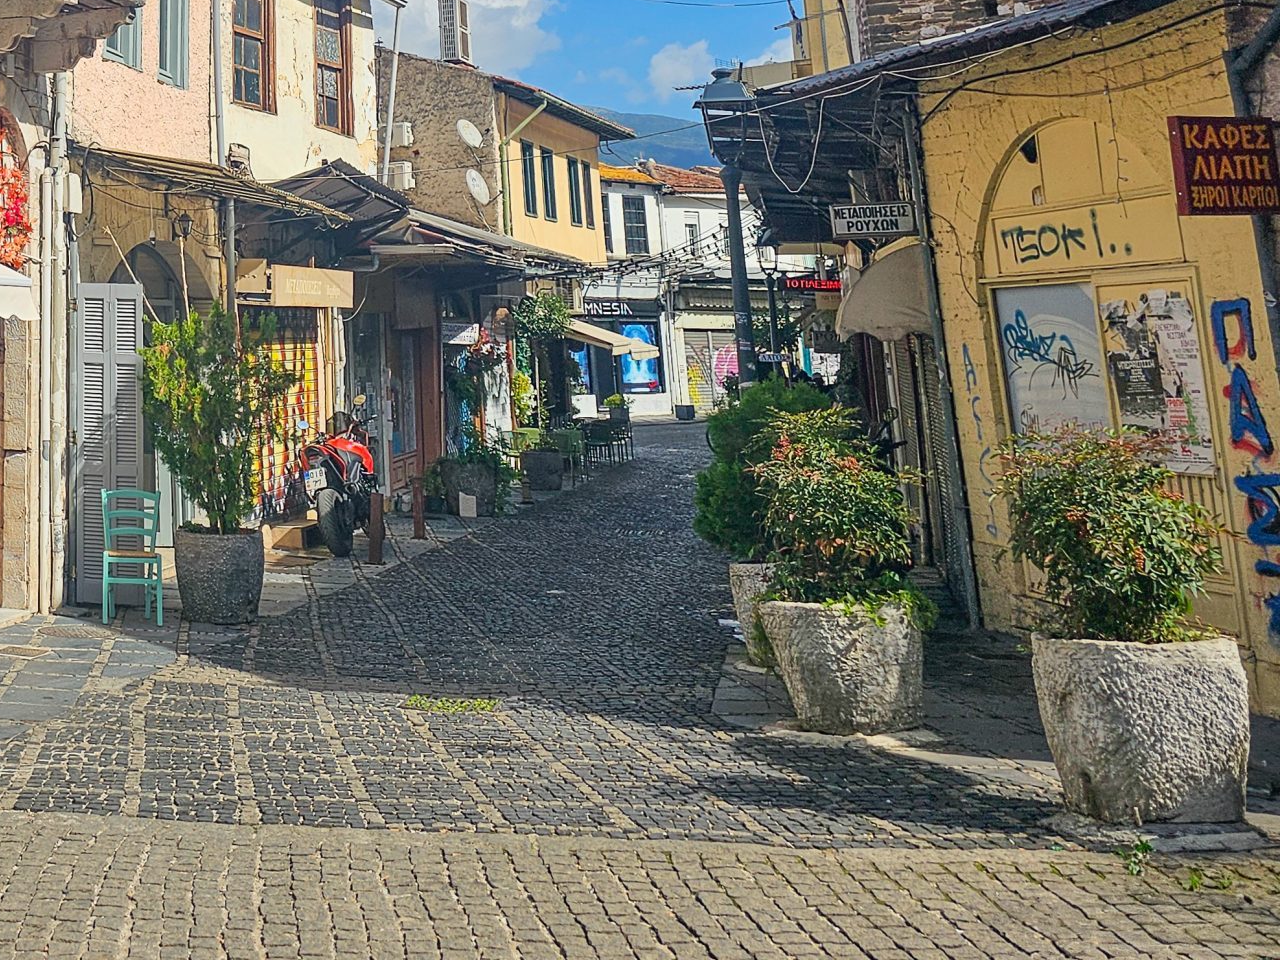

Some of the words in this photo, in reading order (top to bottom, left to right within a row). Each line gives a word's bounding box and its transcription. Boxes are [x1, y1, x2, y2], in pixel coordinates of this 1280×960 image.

[1183, 123, 1270, 149] ΚΑΦΕΣ
[1193, 155, 1272, 180] ΛΙΑΠΗ
[1191, 185, 1231, 209] ΞΗΡΟΙ
[1232, 185, 1280, 208] ΚΑΡΠΟΙ
[834, 205, 909, 220] ΜΕΤΑΠΟΙΗΣΕΙΣ
[846, 218, 899, 233] ΡΟΥΧΩΝ
[785, 279, 799, 289] ΤΟ
[584, 302, 633, 315] MNESIA
